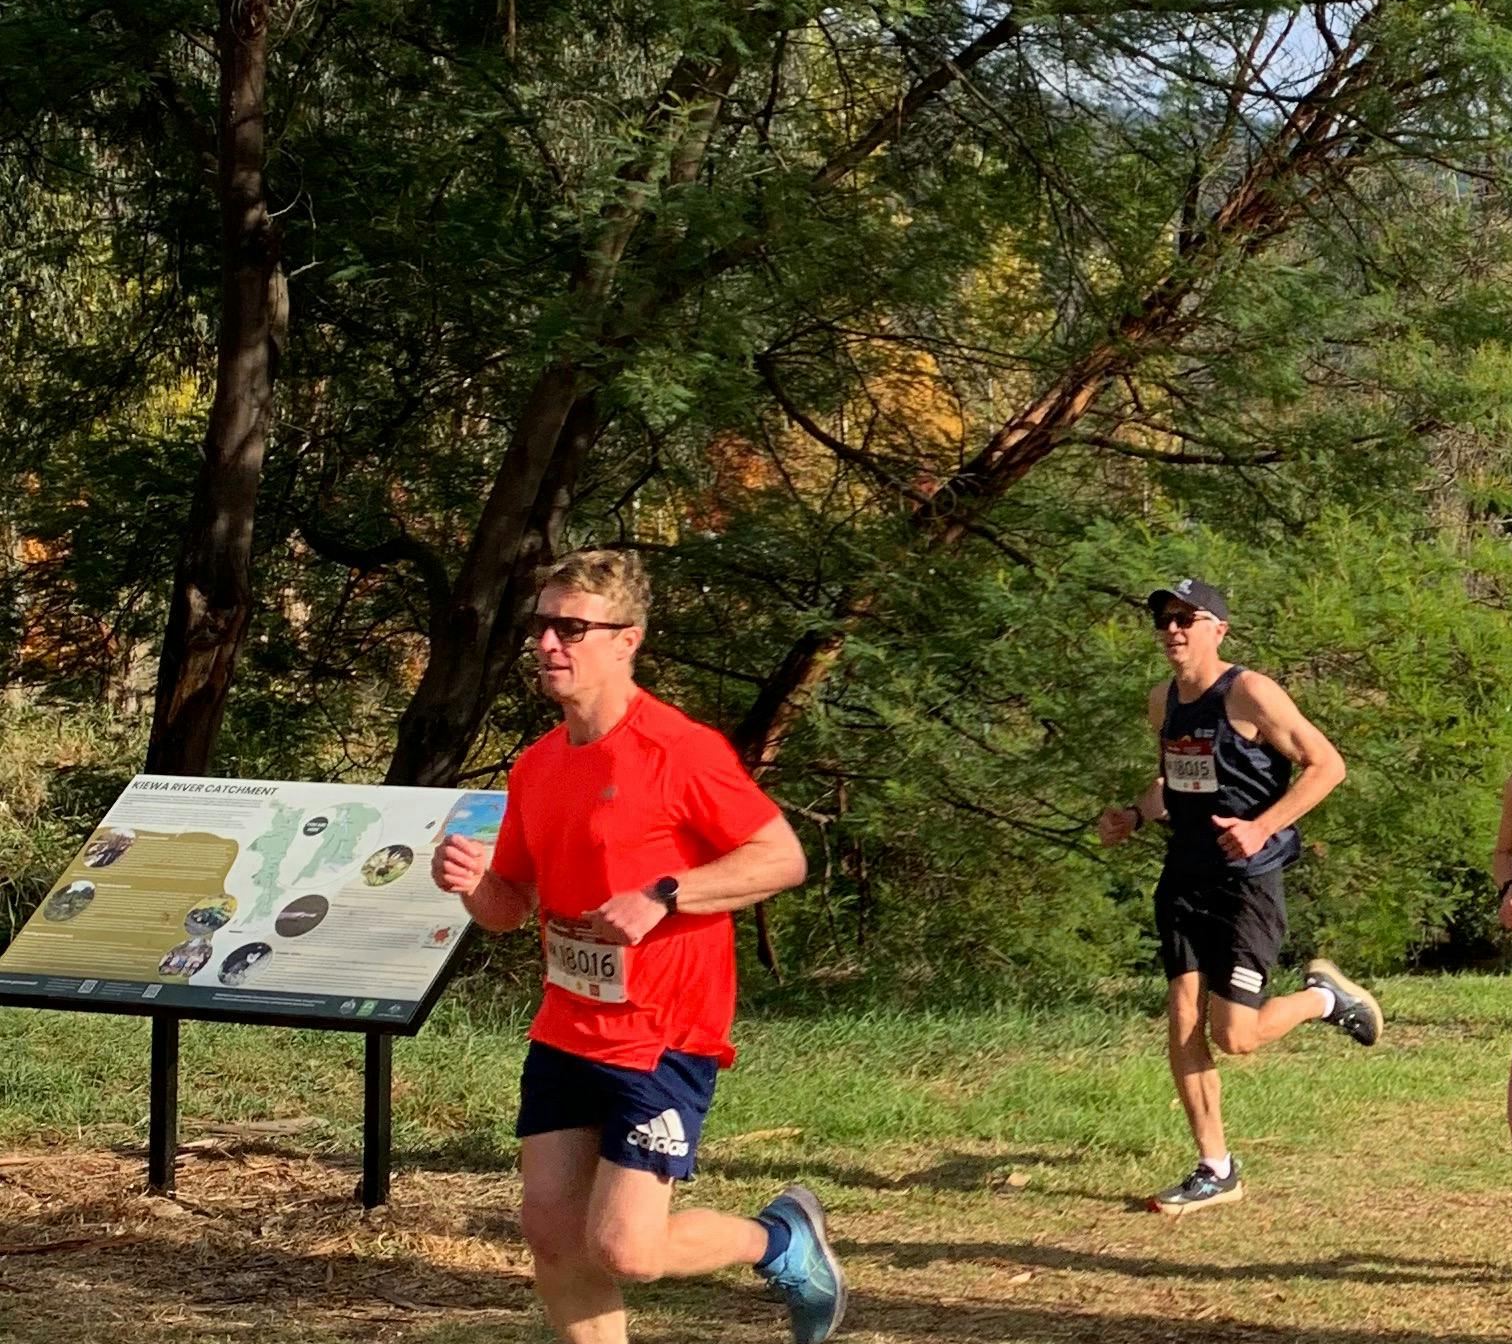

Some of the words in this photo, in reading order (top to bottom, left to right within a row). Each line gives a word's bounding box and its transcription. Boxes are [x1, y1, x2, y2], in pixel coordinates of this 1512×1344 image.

[131, 781, 169, 791] KIEWA
[170, 782, 205, 793] RIVER
[204, 784, 279, 796] CATCHMENT
[559, 944, 615, 978] 18016
[626, 1130, 689, 1157] adidas
